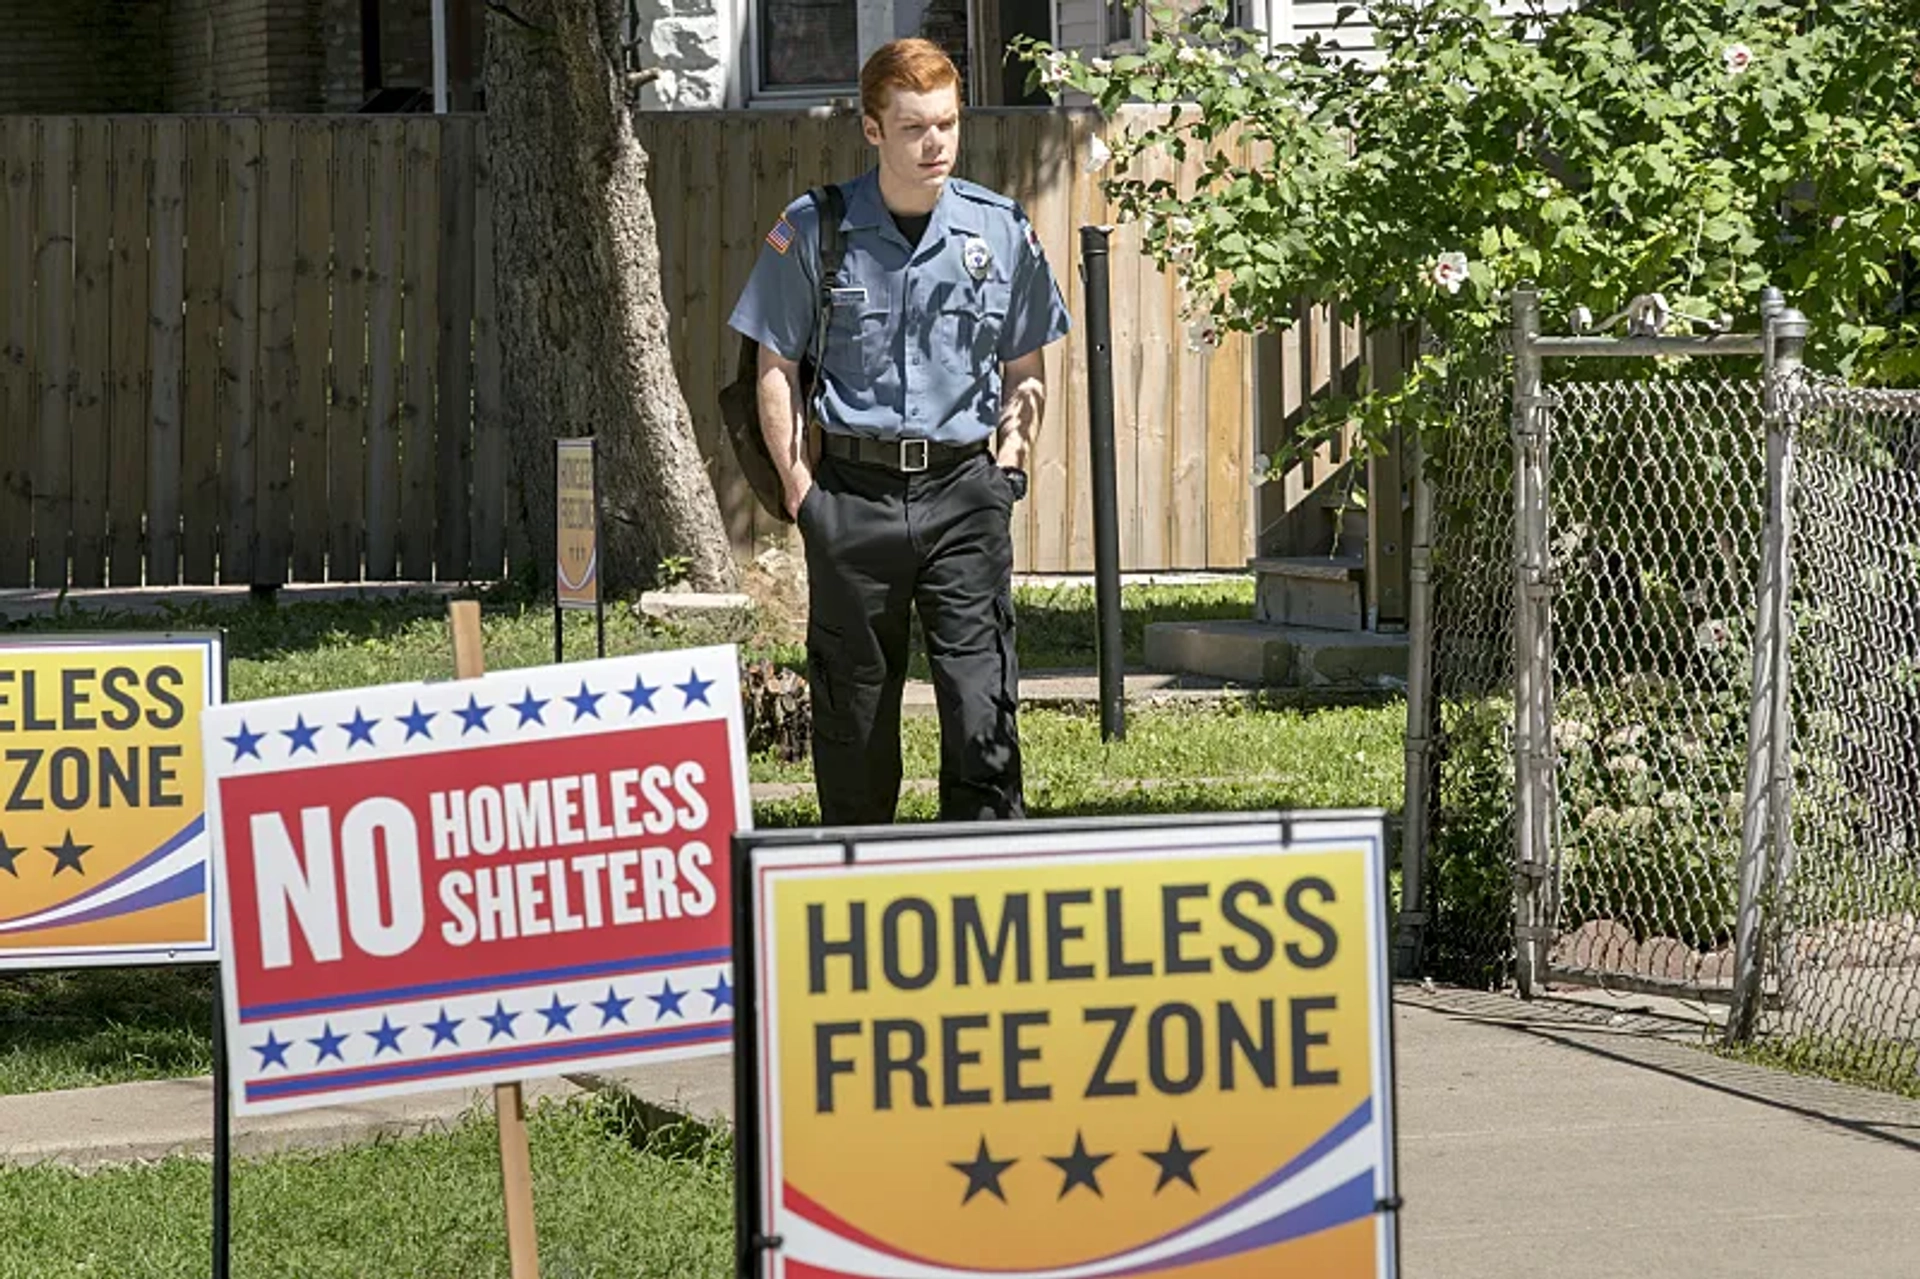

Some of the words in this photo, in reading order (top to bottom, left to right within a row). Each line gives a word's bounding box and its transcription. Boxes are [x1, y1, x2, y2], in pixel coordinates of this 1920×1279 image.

[4, 745, 183, 812] ZONE
[430, 761, 709, 860] HOMELESS
[250, 797, 425, 969] NO
[439, 841, 717, 946] SHELTERS
[807, 877, 1339, 995] HOMELESS
[815, 1004, 1053, 1113] FREE
[1084, 996, 1340, 1099] ZONE
